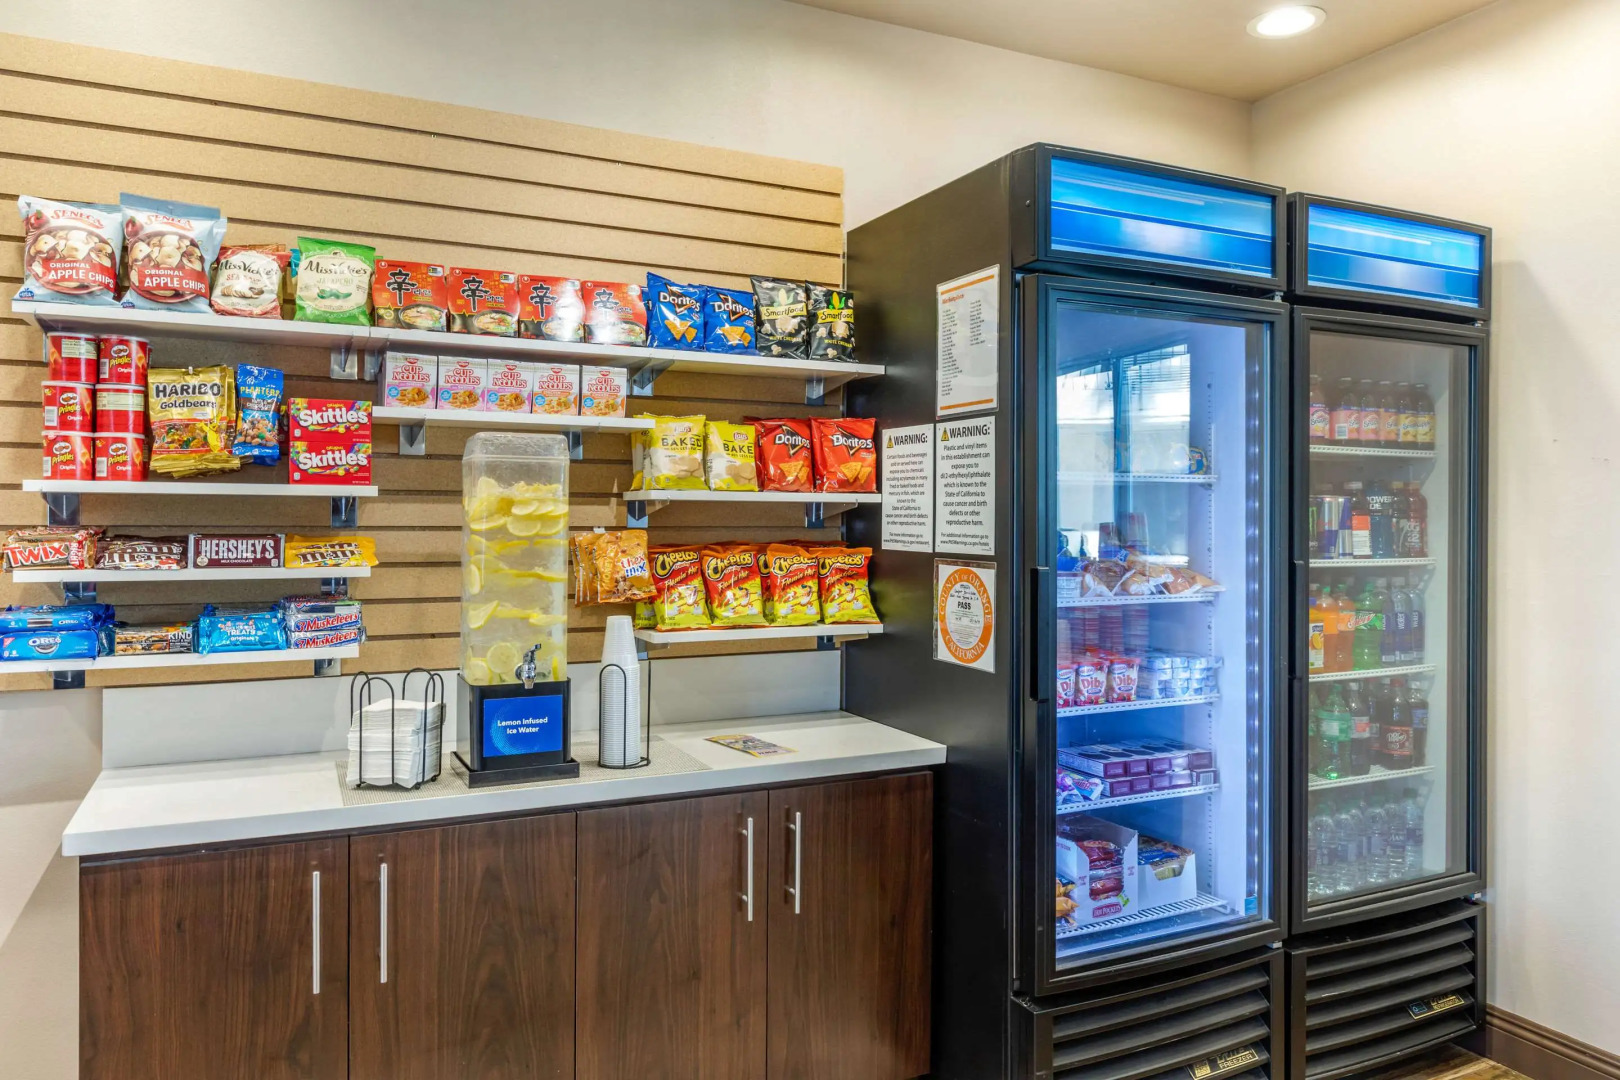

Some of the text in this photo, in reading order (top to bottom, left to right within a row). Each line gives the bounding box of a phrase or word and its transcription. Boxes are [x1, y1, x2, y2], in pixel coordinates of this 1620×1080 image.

[51, 209, 104, 229] SENECA
[145, 214, 193, 231] SENECA
[304, 260, 332, 274] Miss
[49, 268, 114, 289] APPLE CHIPS
[144, 277, 206, 293] APPLE CHIPS
[386, 268, 418, 306] 辛
[461, 276, 490, 312] 辛
[529, 283, 558, 319] 辛
[659, 292, 700, 311] Doritos
[714, 300, 754, 316] Doritos
[764, 305, 804, 316] Smartfood
[820, 308, 853, 320] Smartfood
[110, 356, 132, 368] Pringles
[402, 364, 423, 374] CUP
[392, 372, 430, 382] NOODLES
[453, 368, 474, 377] CUP
[501, 372, 521, 380] CUP
[547, 374, 566, 382] CUP
[444, 375, 480, 385] NOODLES
[539, 381, 573, 390] NOODLES
[595, 378, 614, 386] CUP
[155, 382, 222, 398] HARIBO
[588, 384, 620, 394] NOODLES
[58, 404, 80, 416] Pringles
[160, 400, 216, 410] Goldbears
[299, 408, 369, 427] Skittles
[949, 424, 990, 438] WARNING:
[662, 436, 702, 448] BAKED
[775, 434, 810, 448] Doritos
[832, 434, 873, 448] Doritos
[893, 433, 928, 446] WARNING:
[52, 454, 74, 465] Pringles
[108, 454, 130, 466] Pringles
[298, 450, 368, 470] Skittles
[201, 539, 275, 560] HERSHEY'S
[656, 552, 698, 576] Cheetos
[708, 553, 752, 578] Cheetos
[940, 572, 960, 615] COUNTY
[970, 574, 992, 624] ORANGE
[958, 601, 971, 610] PASS
[306, 613, 358, 631] Musketeers
[28, 636, 62, 646] OREO
[168, 631, 192, 640] KIND
[306, 631, 357, 648] Musketeers
[946, 636, 985, 660] CALIFORNIA
[1219, 1054, 1253, 1069] FREEZER
